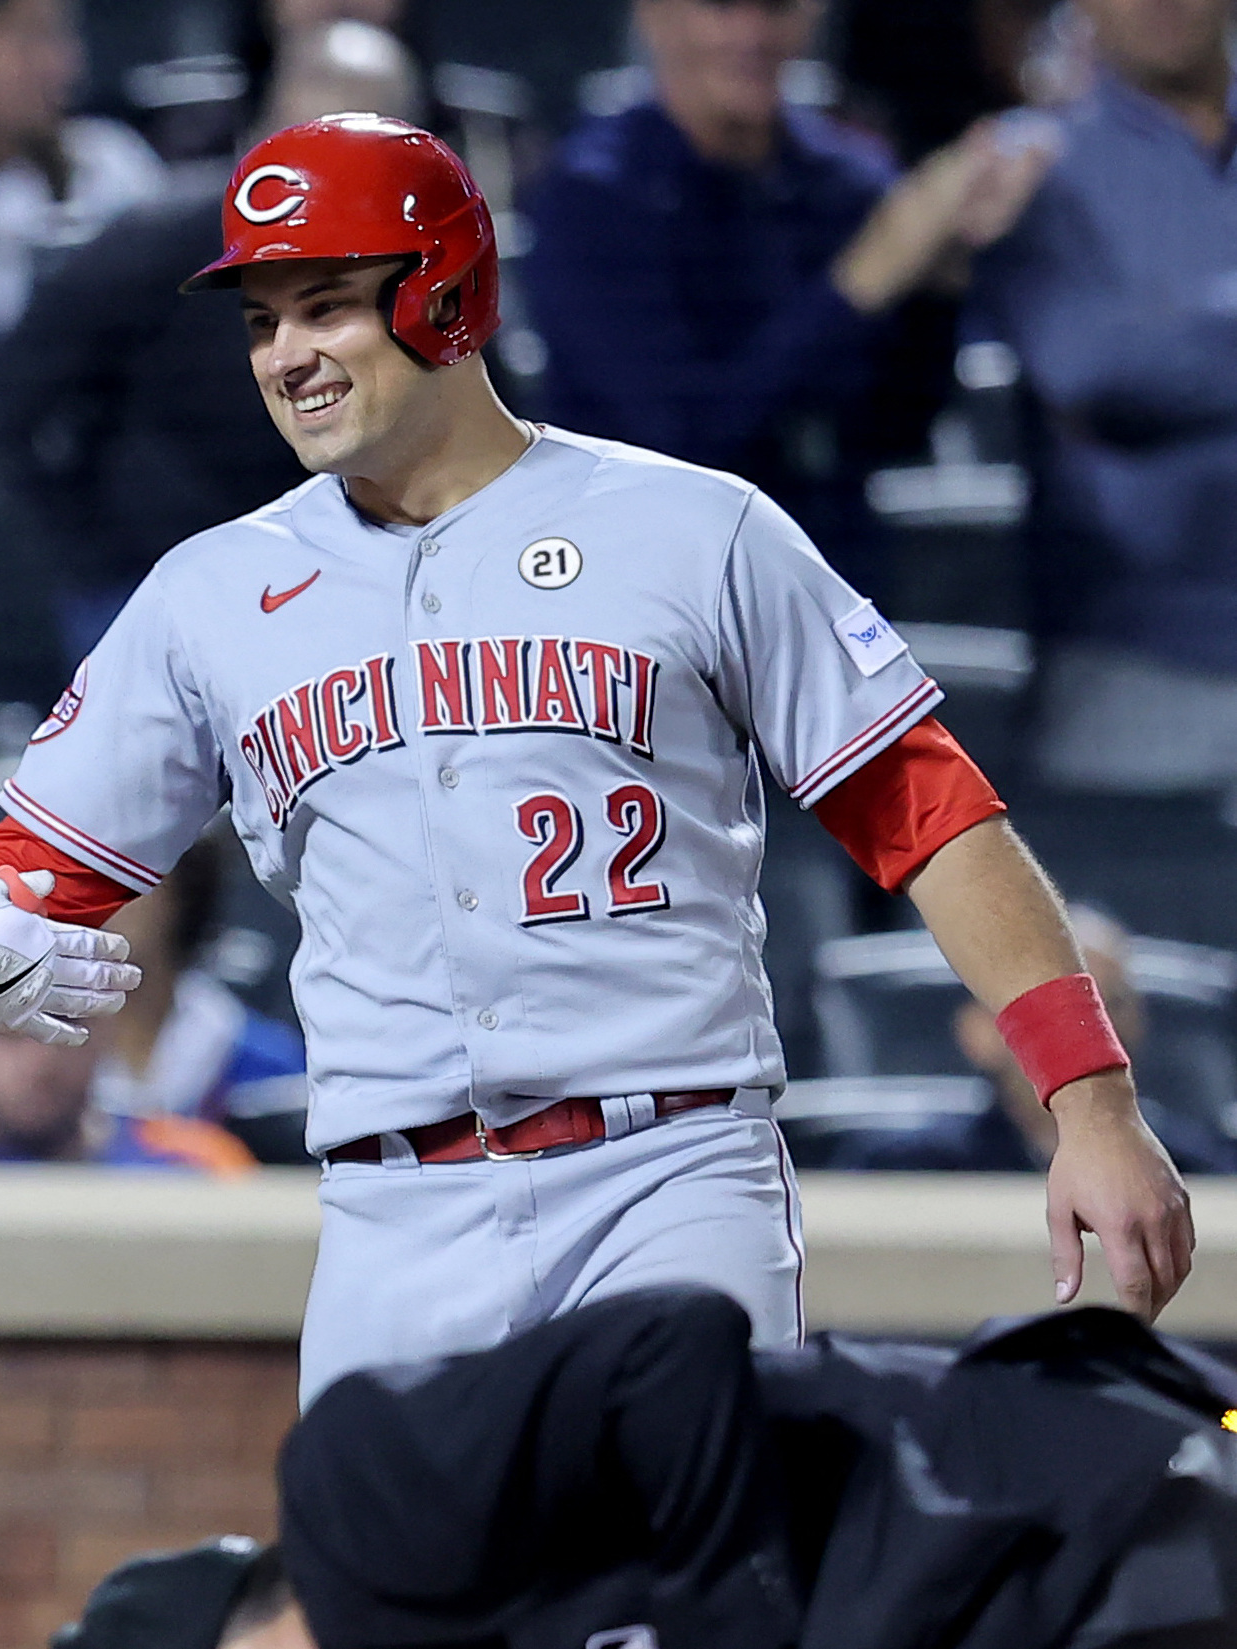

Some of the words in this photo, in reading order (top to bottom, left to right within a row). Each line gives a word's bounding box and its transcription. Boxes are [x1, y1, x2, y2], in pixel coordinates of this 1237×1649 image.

[233, 164, 305, 225] C
[532, 547, 566, 577] 21
[511, 780, 670, 928] 22
